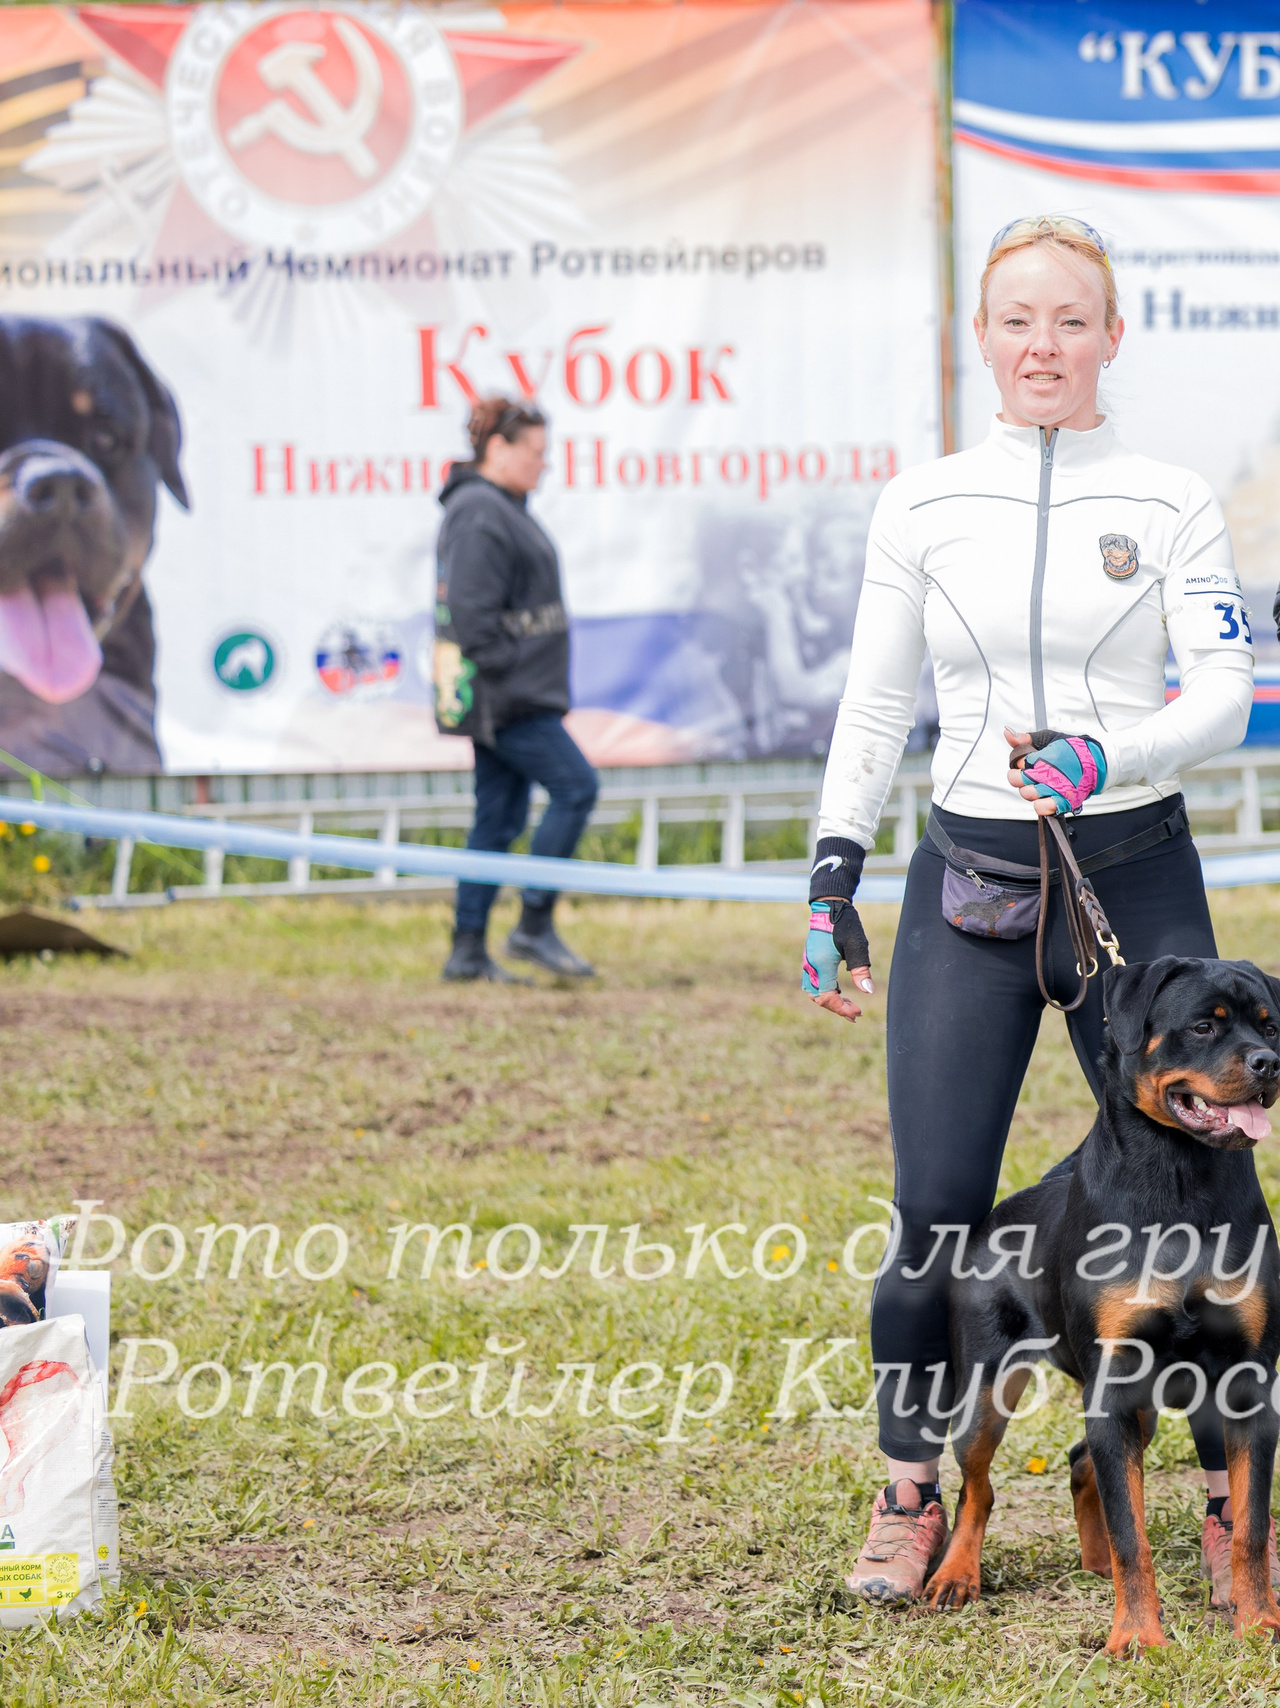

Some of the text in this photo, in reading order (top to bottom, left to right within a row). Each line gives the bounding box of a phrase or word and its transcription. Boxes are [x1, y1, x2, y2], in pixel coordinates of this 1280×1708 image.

[267, 245, 513, 281] Чемпионат
[531, 238, 826, 280] Ротвейлеров
[417, 325, 736, 410] Кубок
[563, 436, 900, 501] Новгорода
[13, 1573, 42, 1581] СОБАК
[21, 1563, 42, 1571] КОРМ
